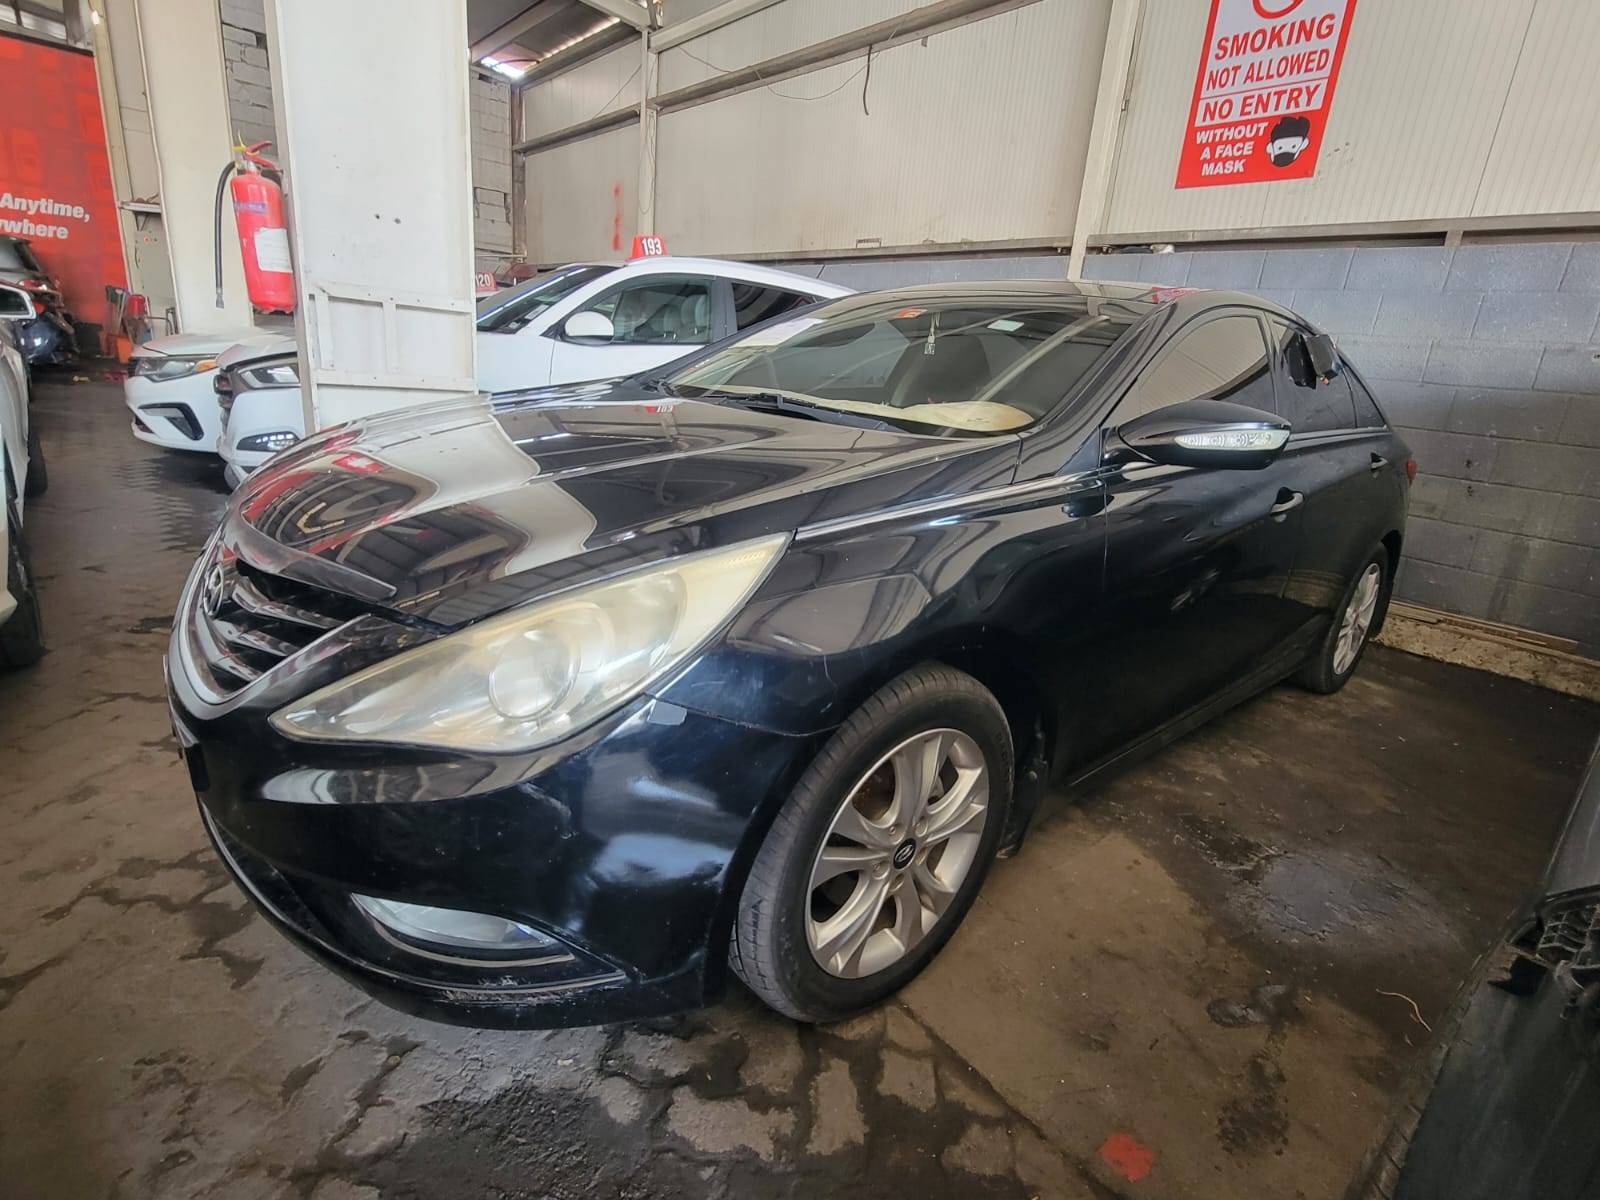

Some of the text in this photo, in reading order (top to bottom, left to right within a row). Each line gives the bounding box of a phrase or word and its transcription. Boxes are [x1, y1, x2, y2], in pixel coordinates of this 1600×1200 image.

[1214, 13, 1336, 61] SMOKING
[1206, 48, 1330, 91] NOT ALLOWED
[1202, 83, 1322, 123] NO ENTRY
[1195, 121, 1269, 145] WITHOUT
[1200, 141, 1255, 161] A FACE
[1201, 159, 1246, 177] MASK
[0, 192, 90, 223] Anytime,
[641, 237, 663, 256] 193
